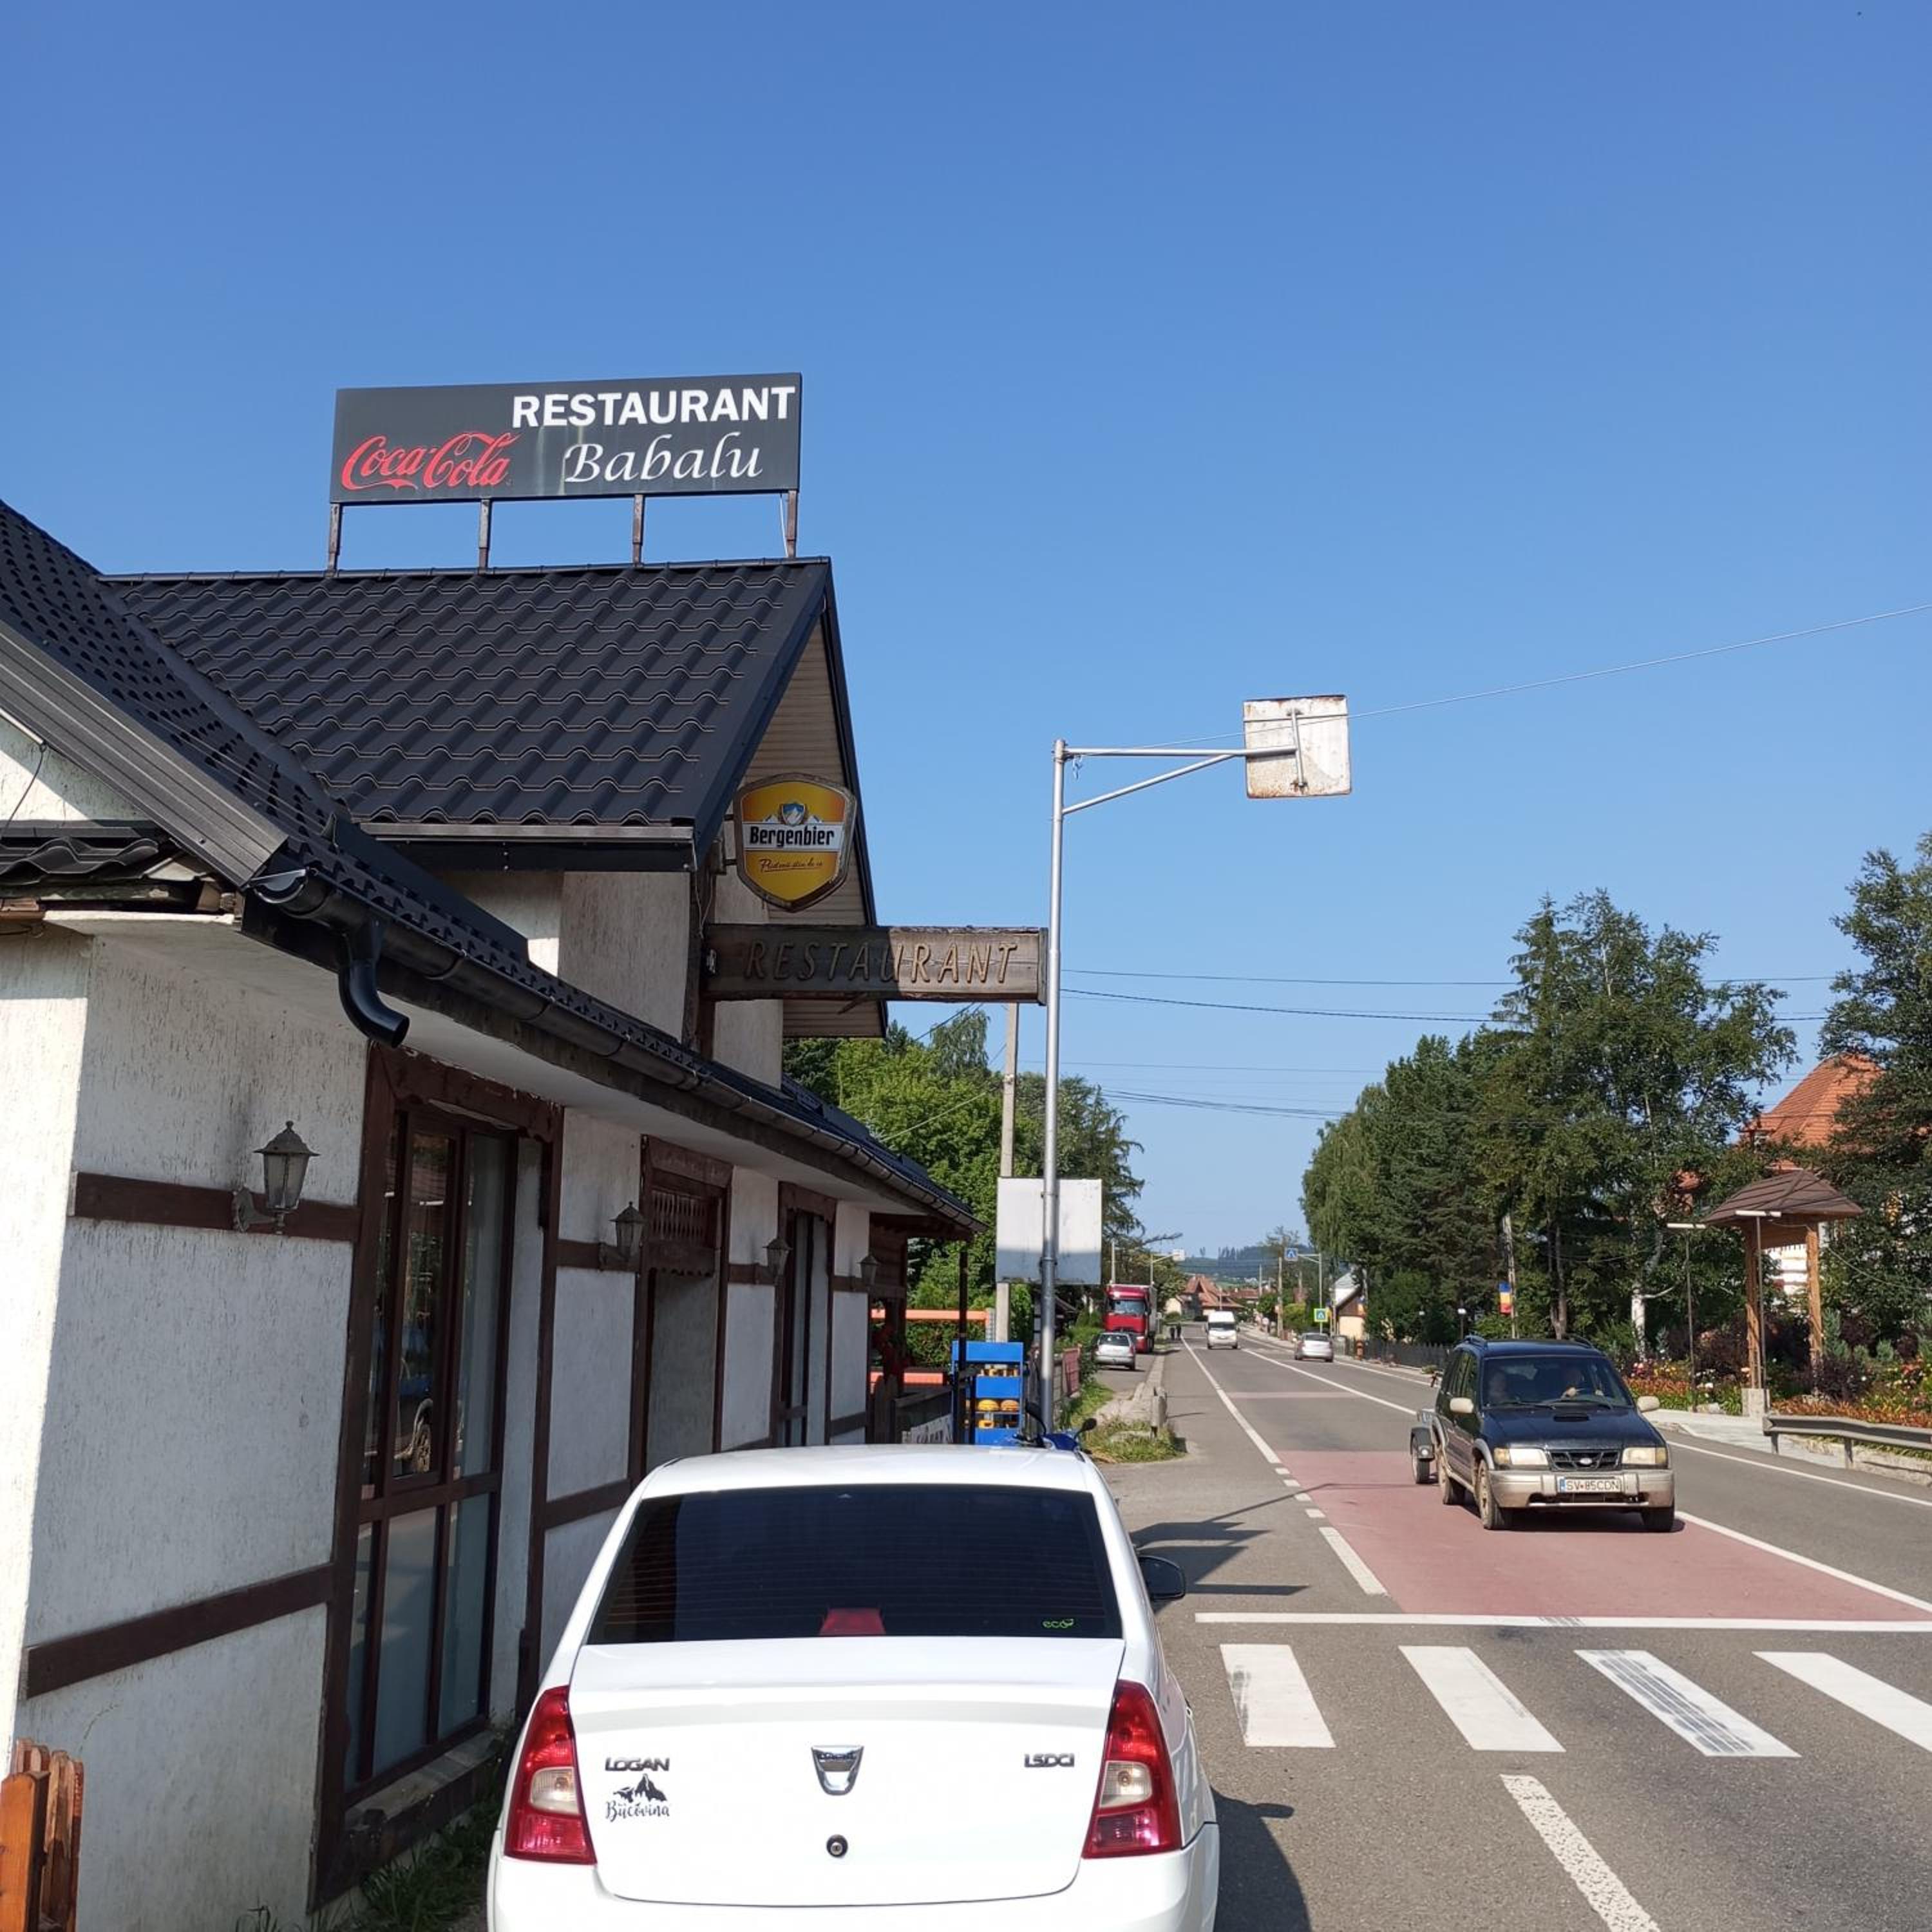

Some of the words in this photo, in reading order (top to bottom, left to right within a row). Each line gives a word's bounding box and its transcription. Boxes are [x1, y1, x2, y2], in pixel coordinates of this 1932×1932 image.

[513, 387, 795, 428] RESTAURANT
[341, 430, 521, 490] Coca-Cola
[564, 431, 762, 482] Babalu
[750, 825, 835, 847] Bergenbier
[745, 942, 1018, 983] RESTAURANT
[605, 1757, 670, 1772] LOGAN
